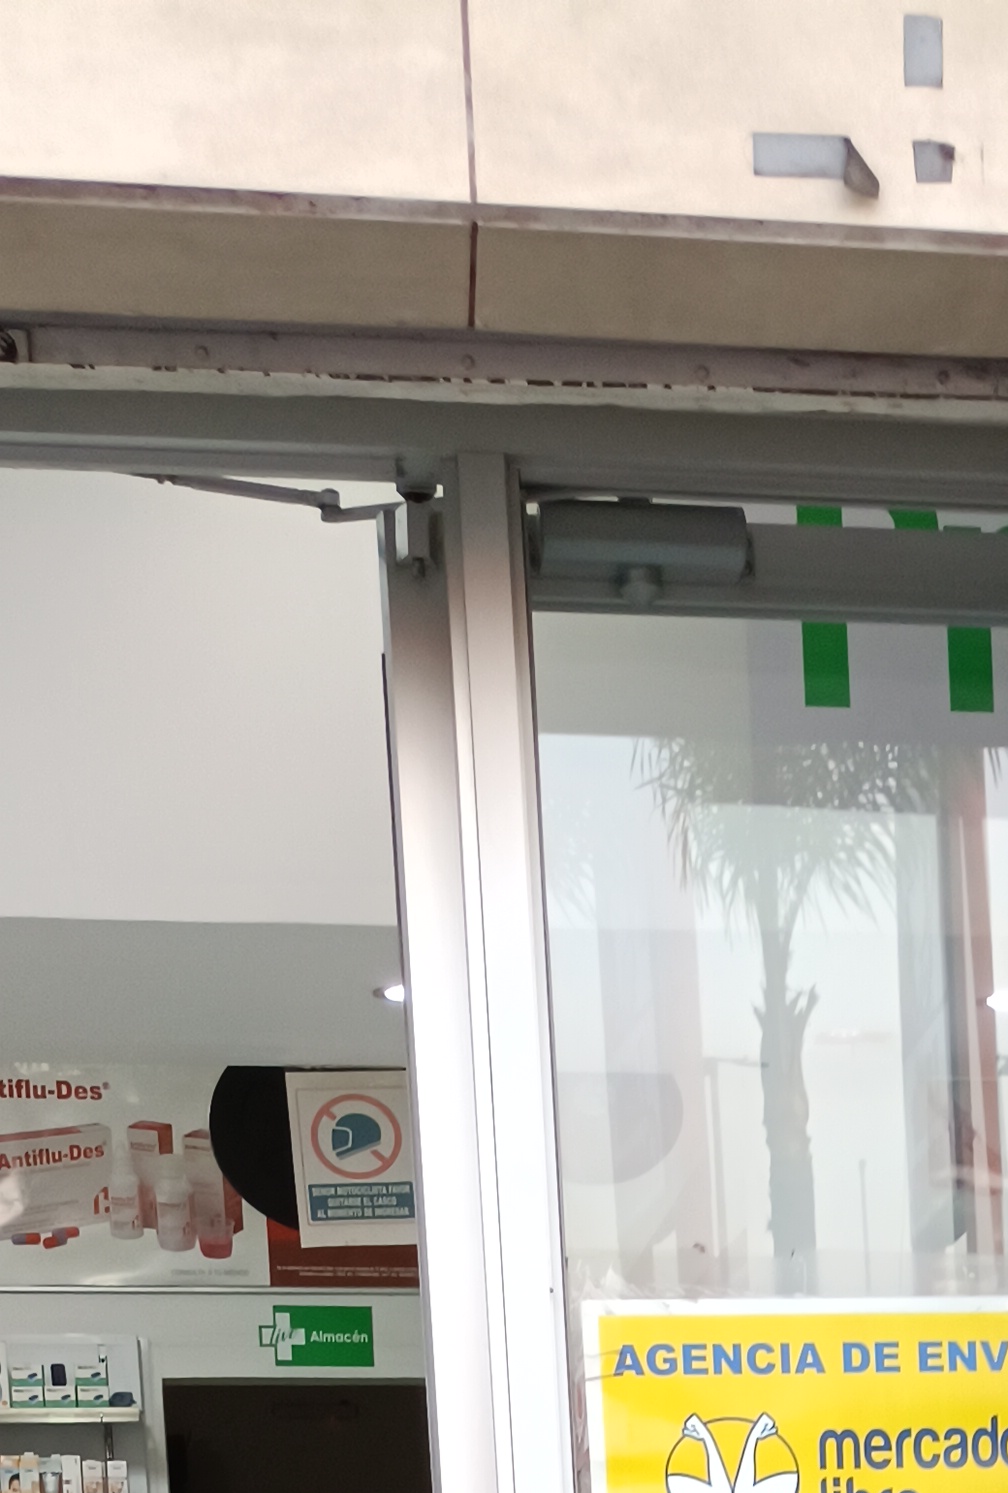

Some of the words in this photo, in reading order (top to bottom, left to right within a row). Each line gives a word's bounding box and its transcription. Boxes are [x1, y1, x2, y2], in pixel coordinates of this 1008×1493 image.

[310, 1330, 369, 1344] Almacén
[614, 1343, 826, 1377] AGENCIA
[842, 1341, 901, 1375] DE
